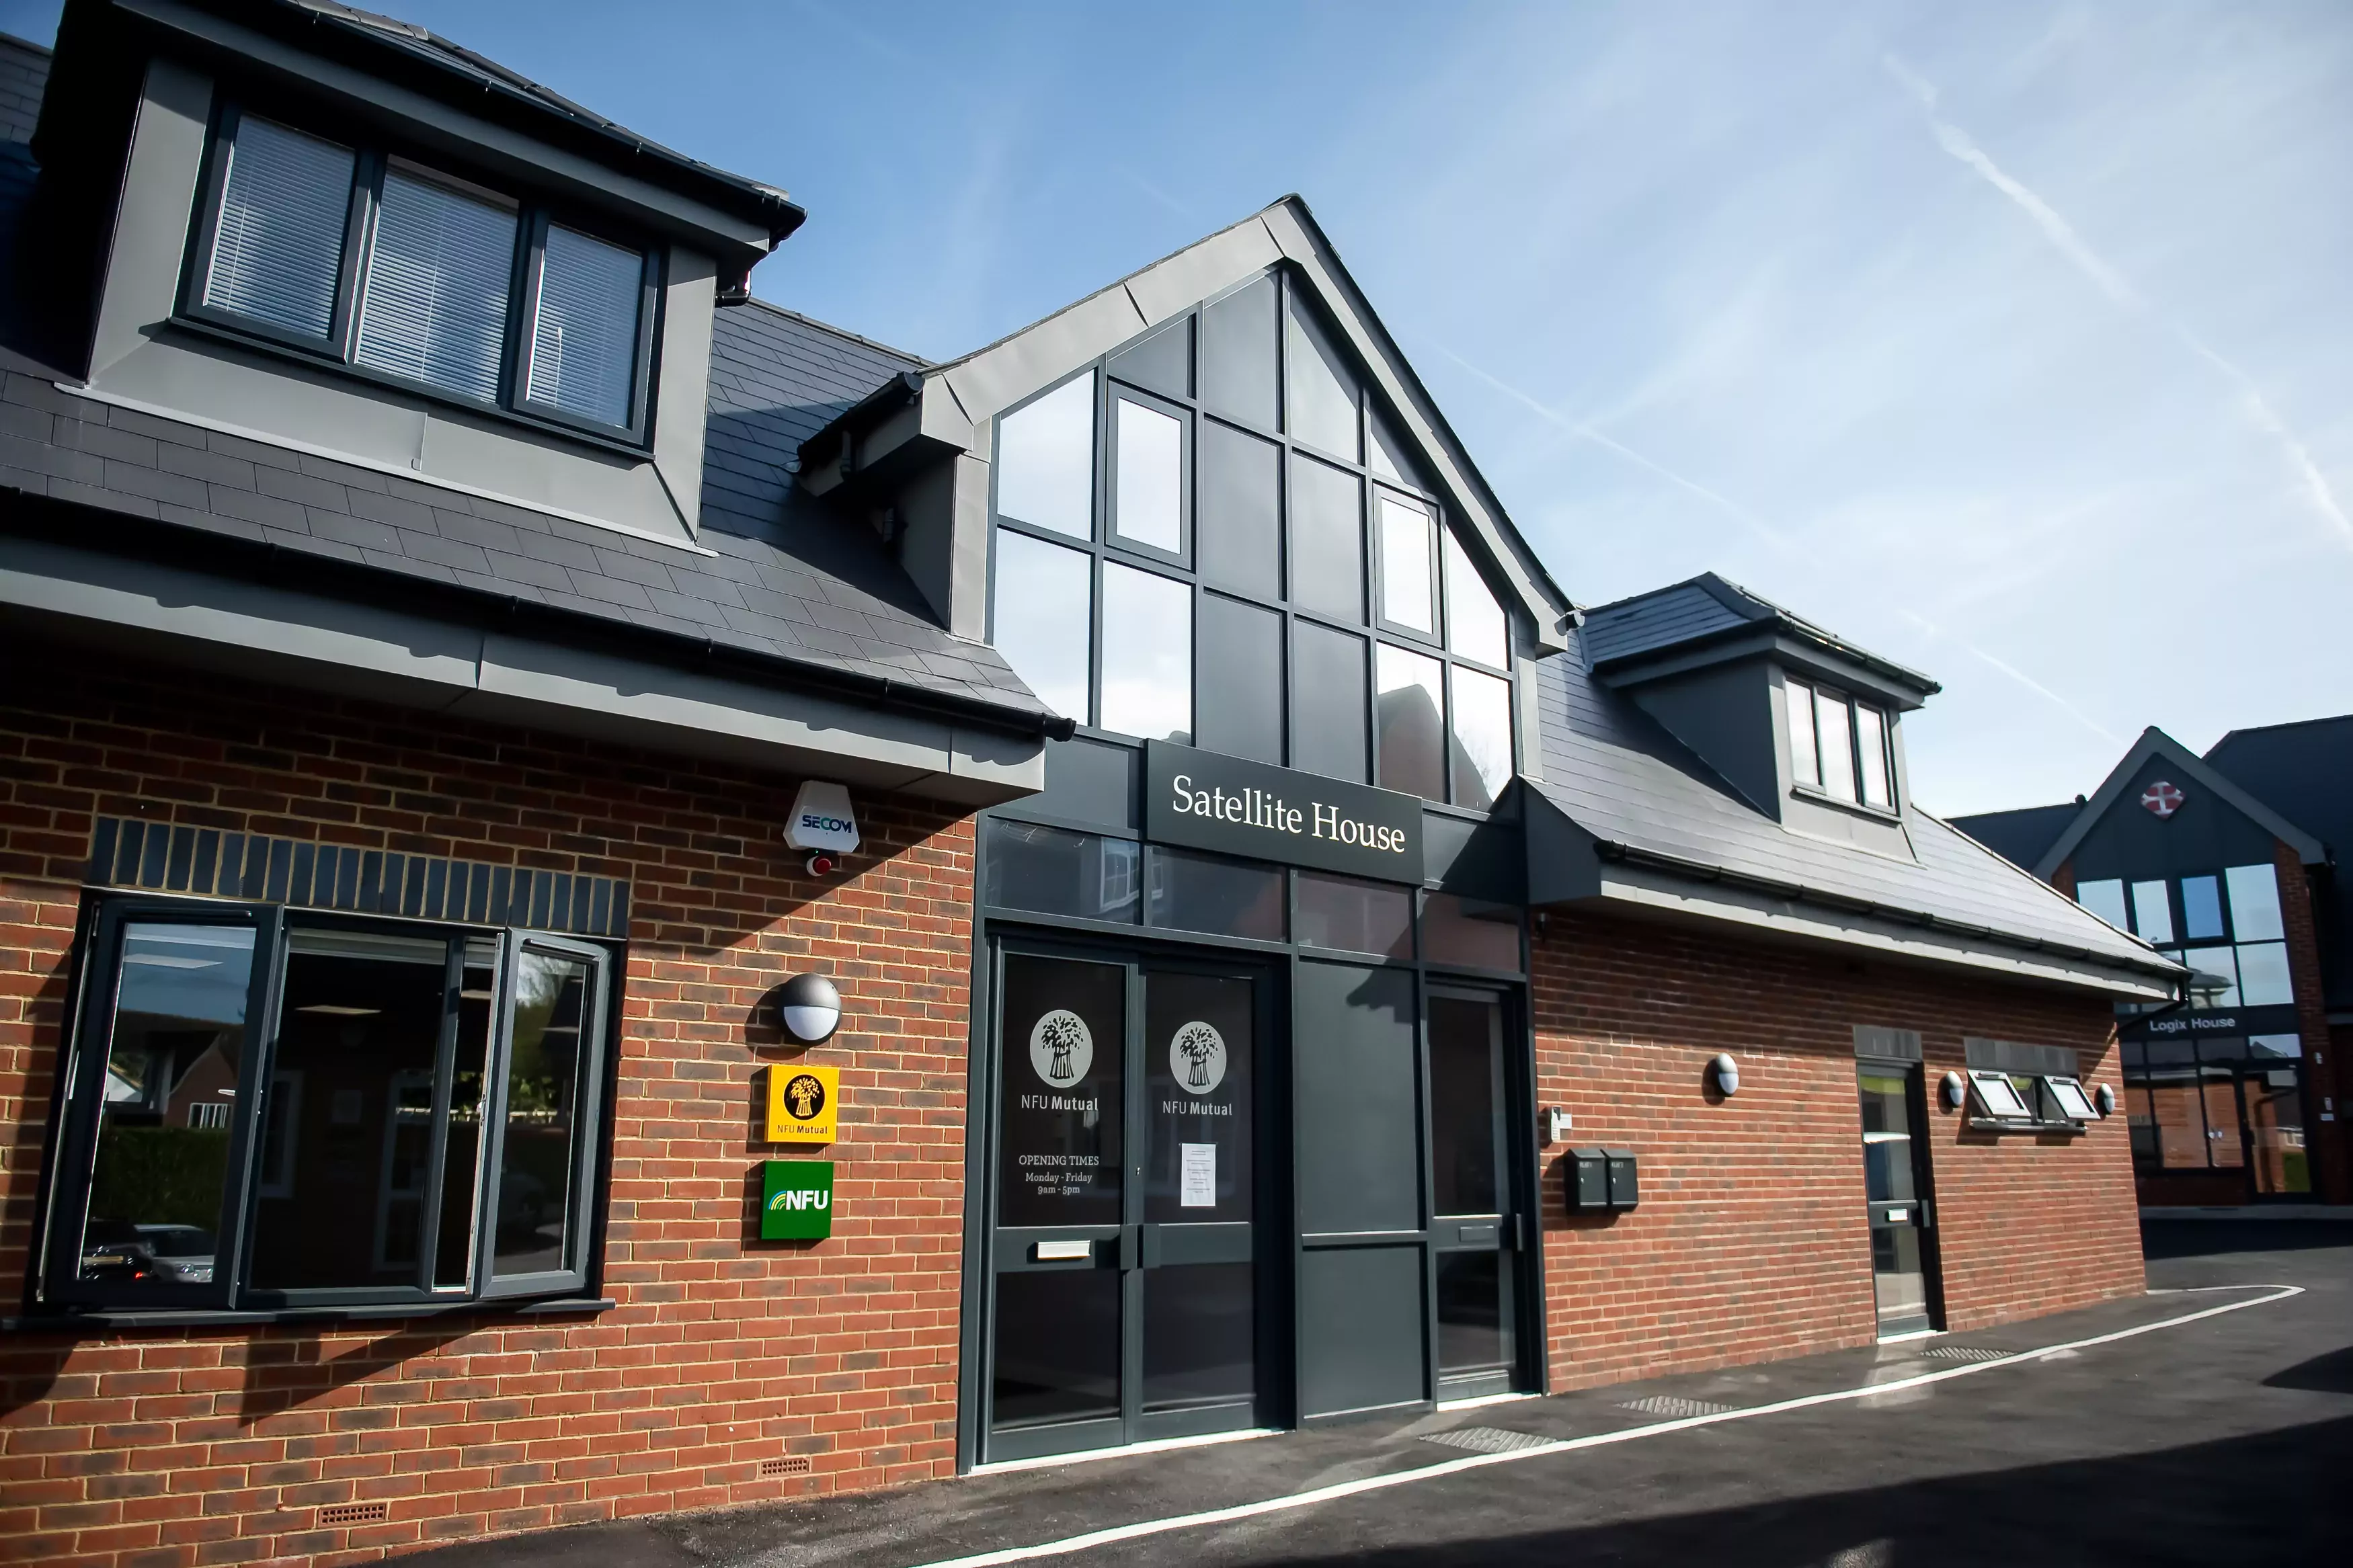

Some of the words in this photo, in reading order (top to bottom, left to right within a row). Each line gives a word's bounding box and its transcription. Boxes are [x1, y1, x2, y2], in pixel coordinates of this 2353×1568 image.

[1172, 774, 1303, 834] Satellite
[1311, 802, 1406, 853] House
[803, 815, 852, 833] SECOM
[2150, 1019, 2187, 1033] Logix
[2191, 1018, 2235, 1029] House
[1021, 1094, 1048, 1109] NFU
[1051, 1096, 1099, 1111] Mutual
[1162, 1100, 1187, 1114] NFU
[1190, 1102, 1232, 1116] Mutual
[777, 1124, 795, 1133] NFU
[797, 1125, 828, 1134] Mutual
[1019, 1155, 1066, 1165] OPENING
[1069, 1155, 1099, 1165] TIMES
[1025, 1171, 1060, 1184] Monday
[1066, 1171, 1092, 1184] Friday
[1037, 1186, 1056, 1195] 9am
[1062, 1186, 1080, 1196] 5pm
[785, 1190, 829, 1210] NFU
